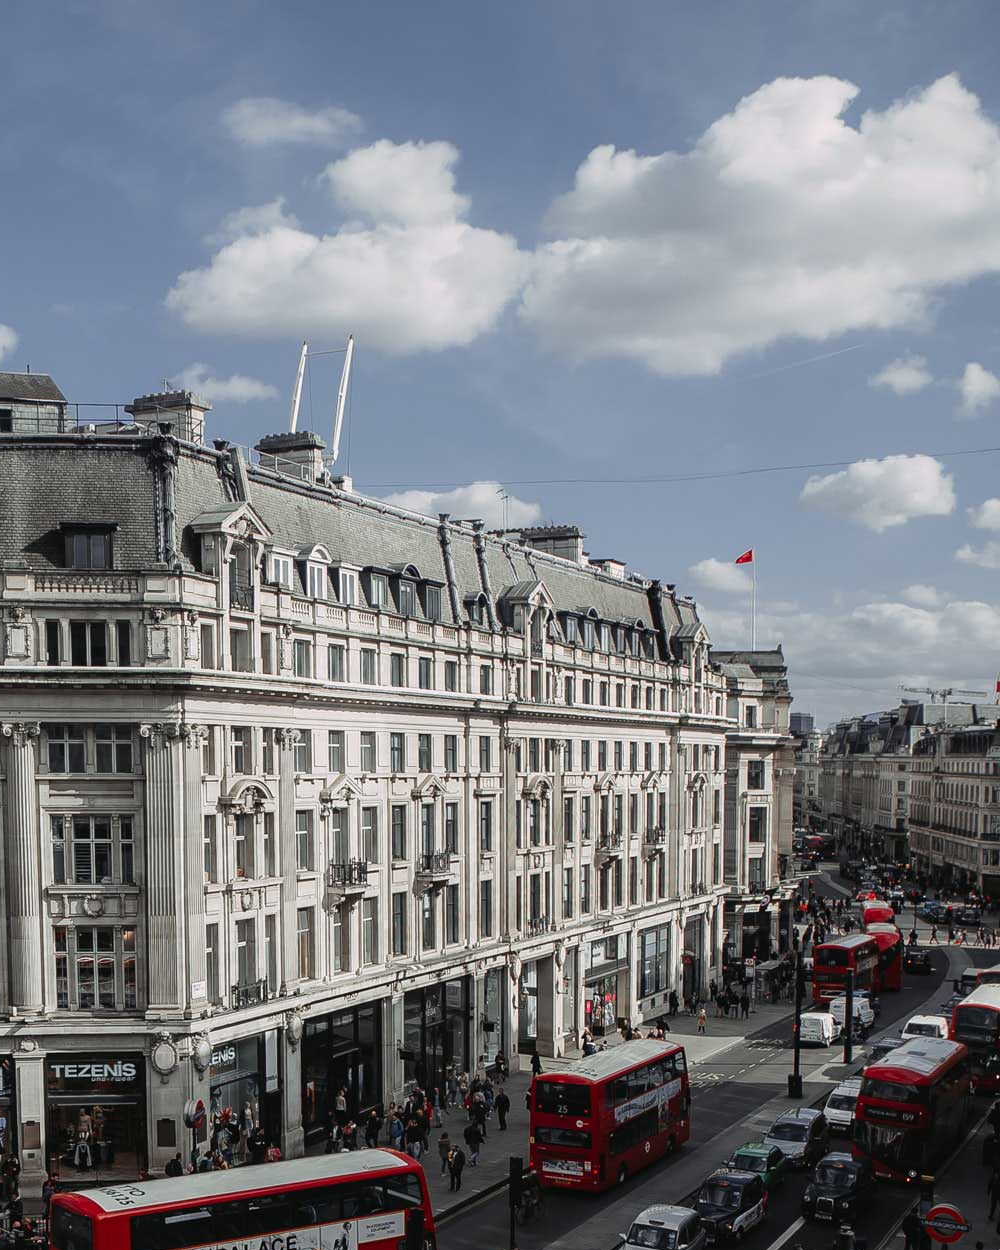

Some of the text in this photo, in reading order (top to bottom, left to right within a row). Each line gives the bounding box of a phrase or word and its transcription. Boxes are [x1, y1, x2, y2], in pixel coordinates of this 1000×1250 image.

[209, 1046, 236, 1066] ENIS
[50, 1060, 137, 1078] TEZENIS
[558, 1104, 568, 1113] 25
